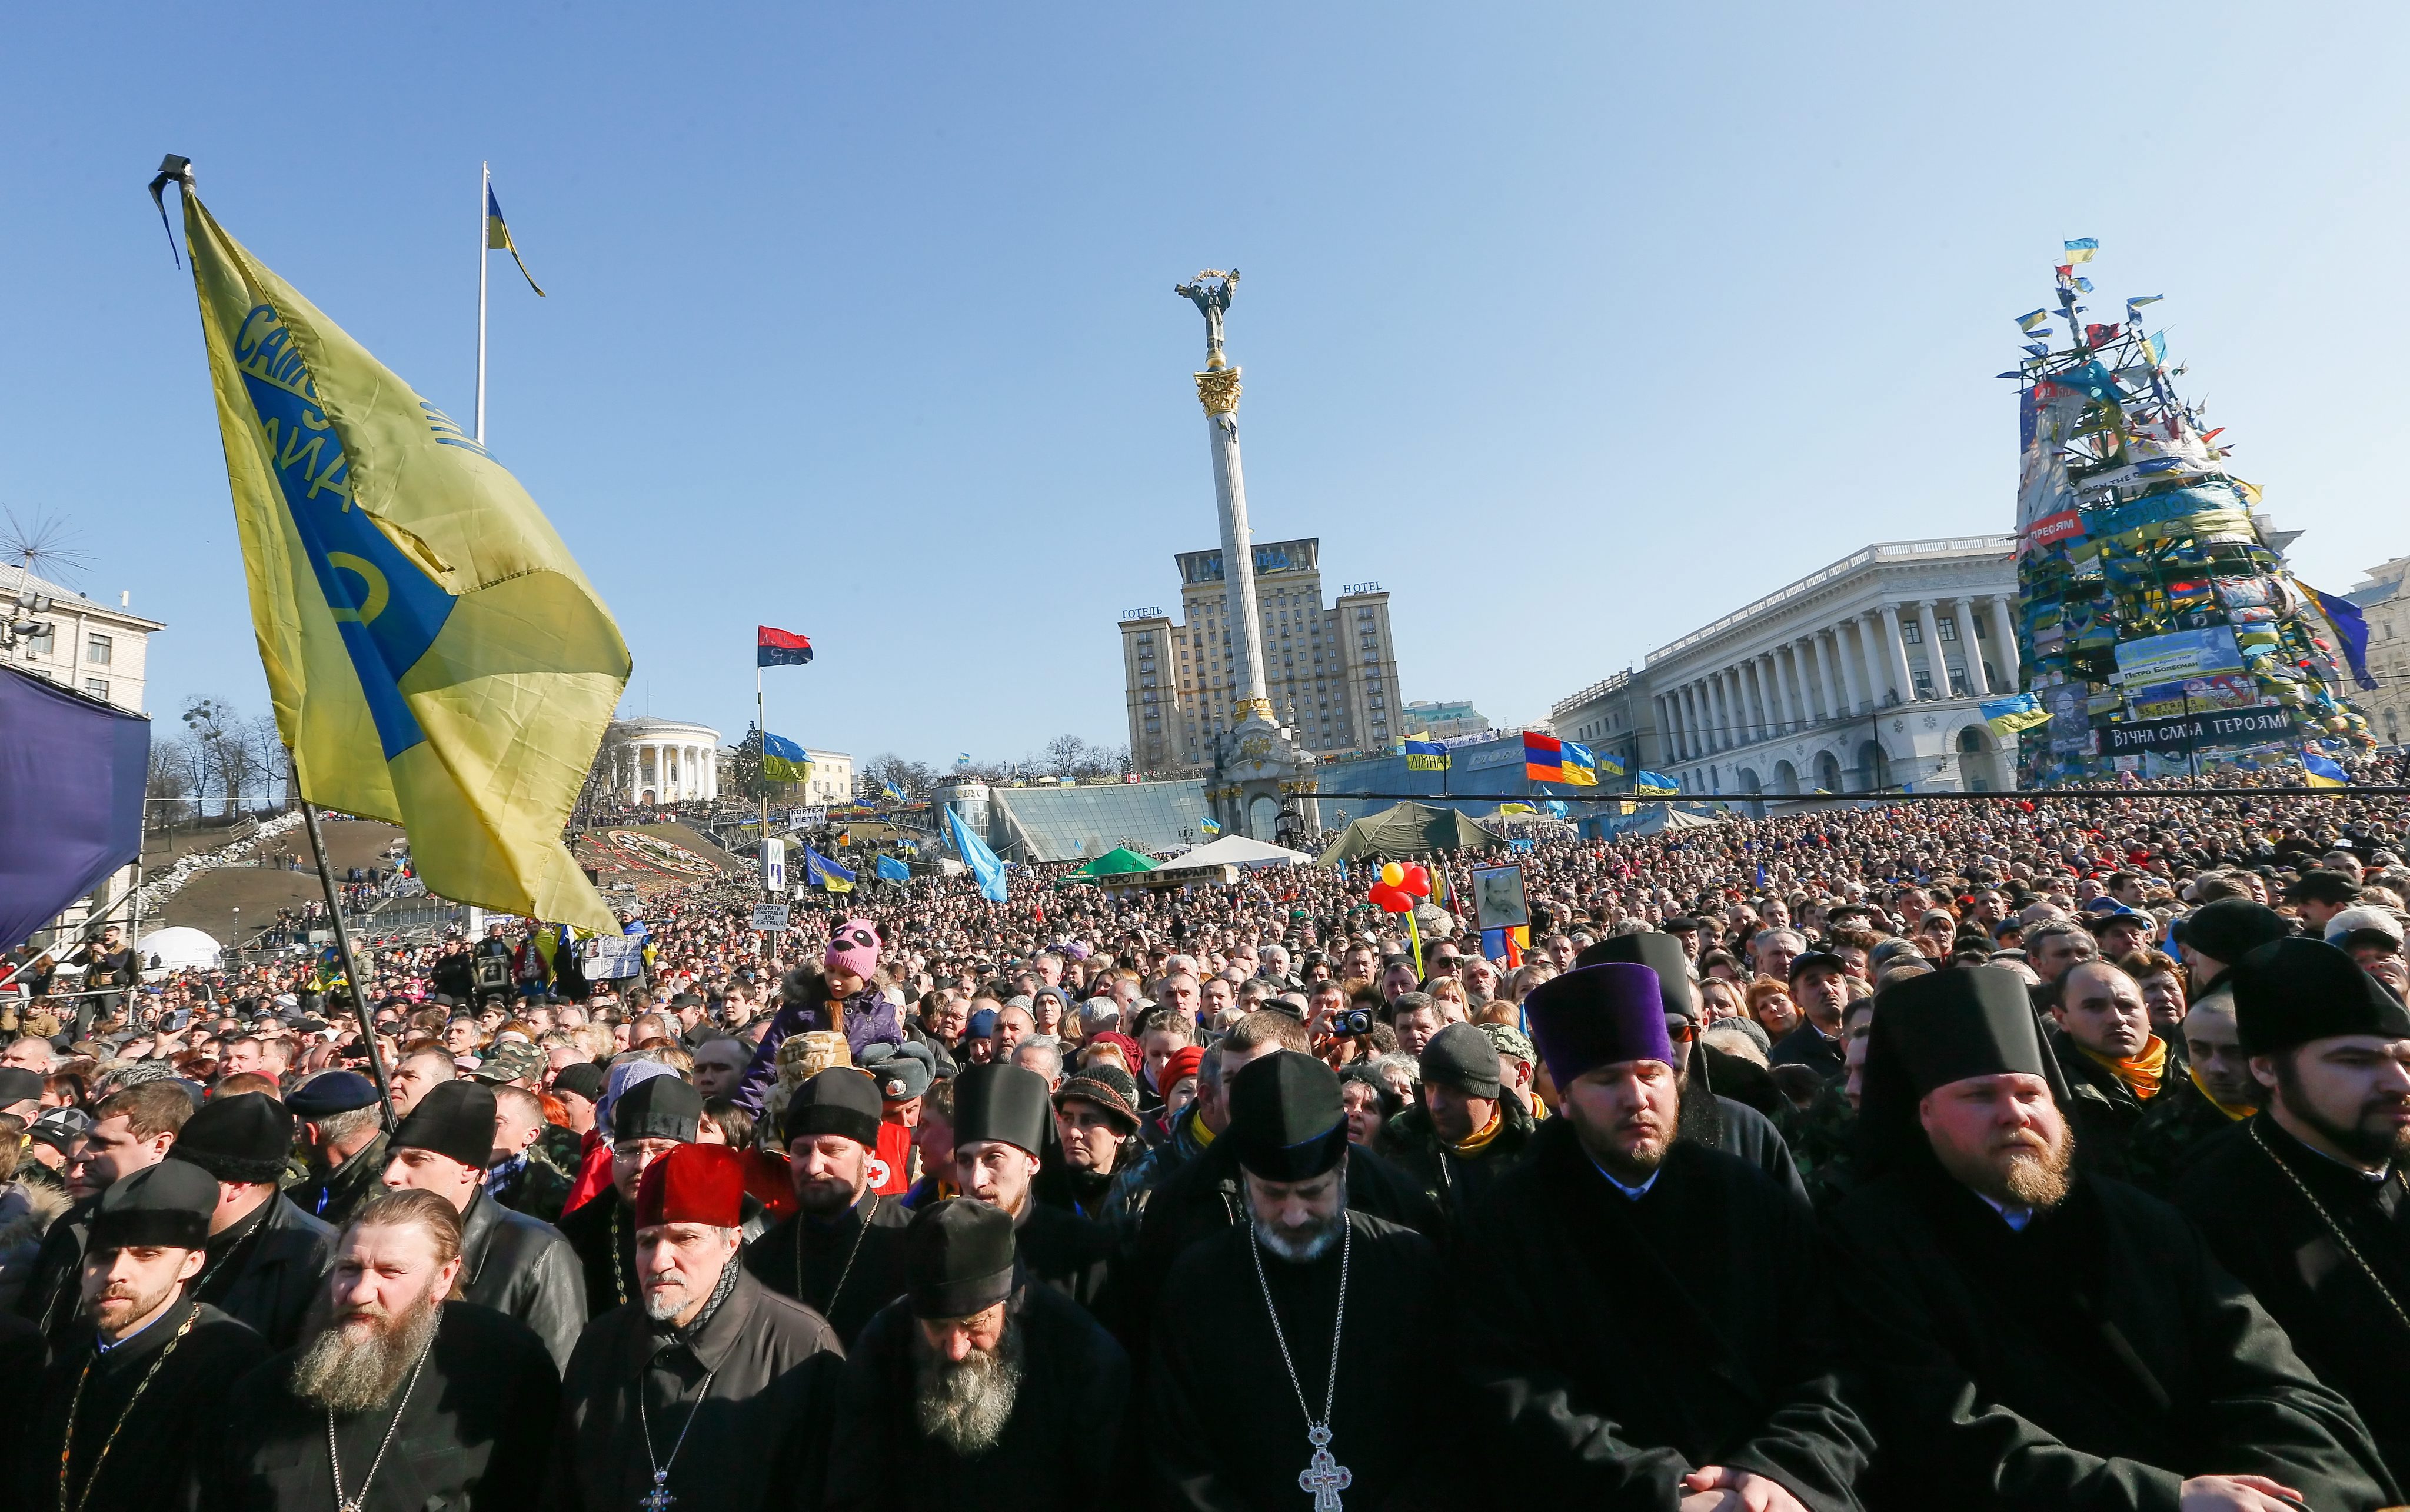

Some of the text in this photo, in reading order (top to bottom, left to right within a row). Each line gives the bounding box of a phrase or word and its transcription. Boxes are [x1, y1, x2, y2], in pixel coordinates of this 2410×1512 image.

[2110, 474, 2131, 484] THE
[1343, 581, 1383, 594] HOTEL
[1121, 605, 1163, 619] ГОТЕЛЬ
[2156, 699, 2197, 711] ВТРАА
[2111, 728, 2155, 747] ВІЧНА
[1101, 874, 1136, 885] ГЕРОЇ
[1144, 872, 1157, 882] НЕ
[1164, 866, 1220, 879] ВМИРАЮТЬ
